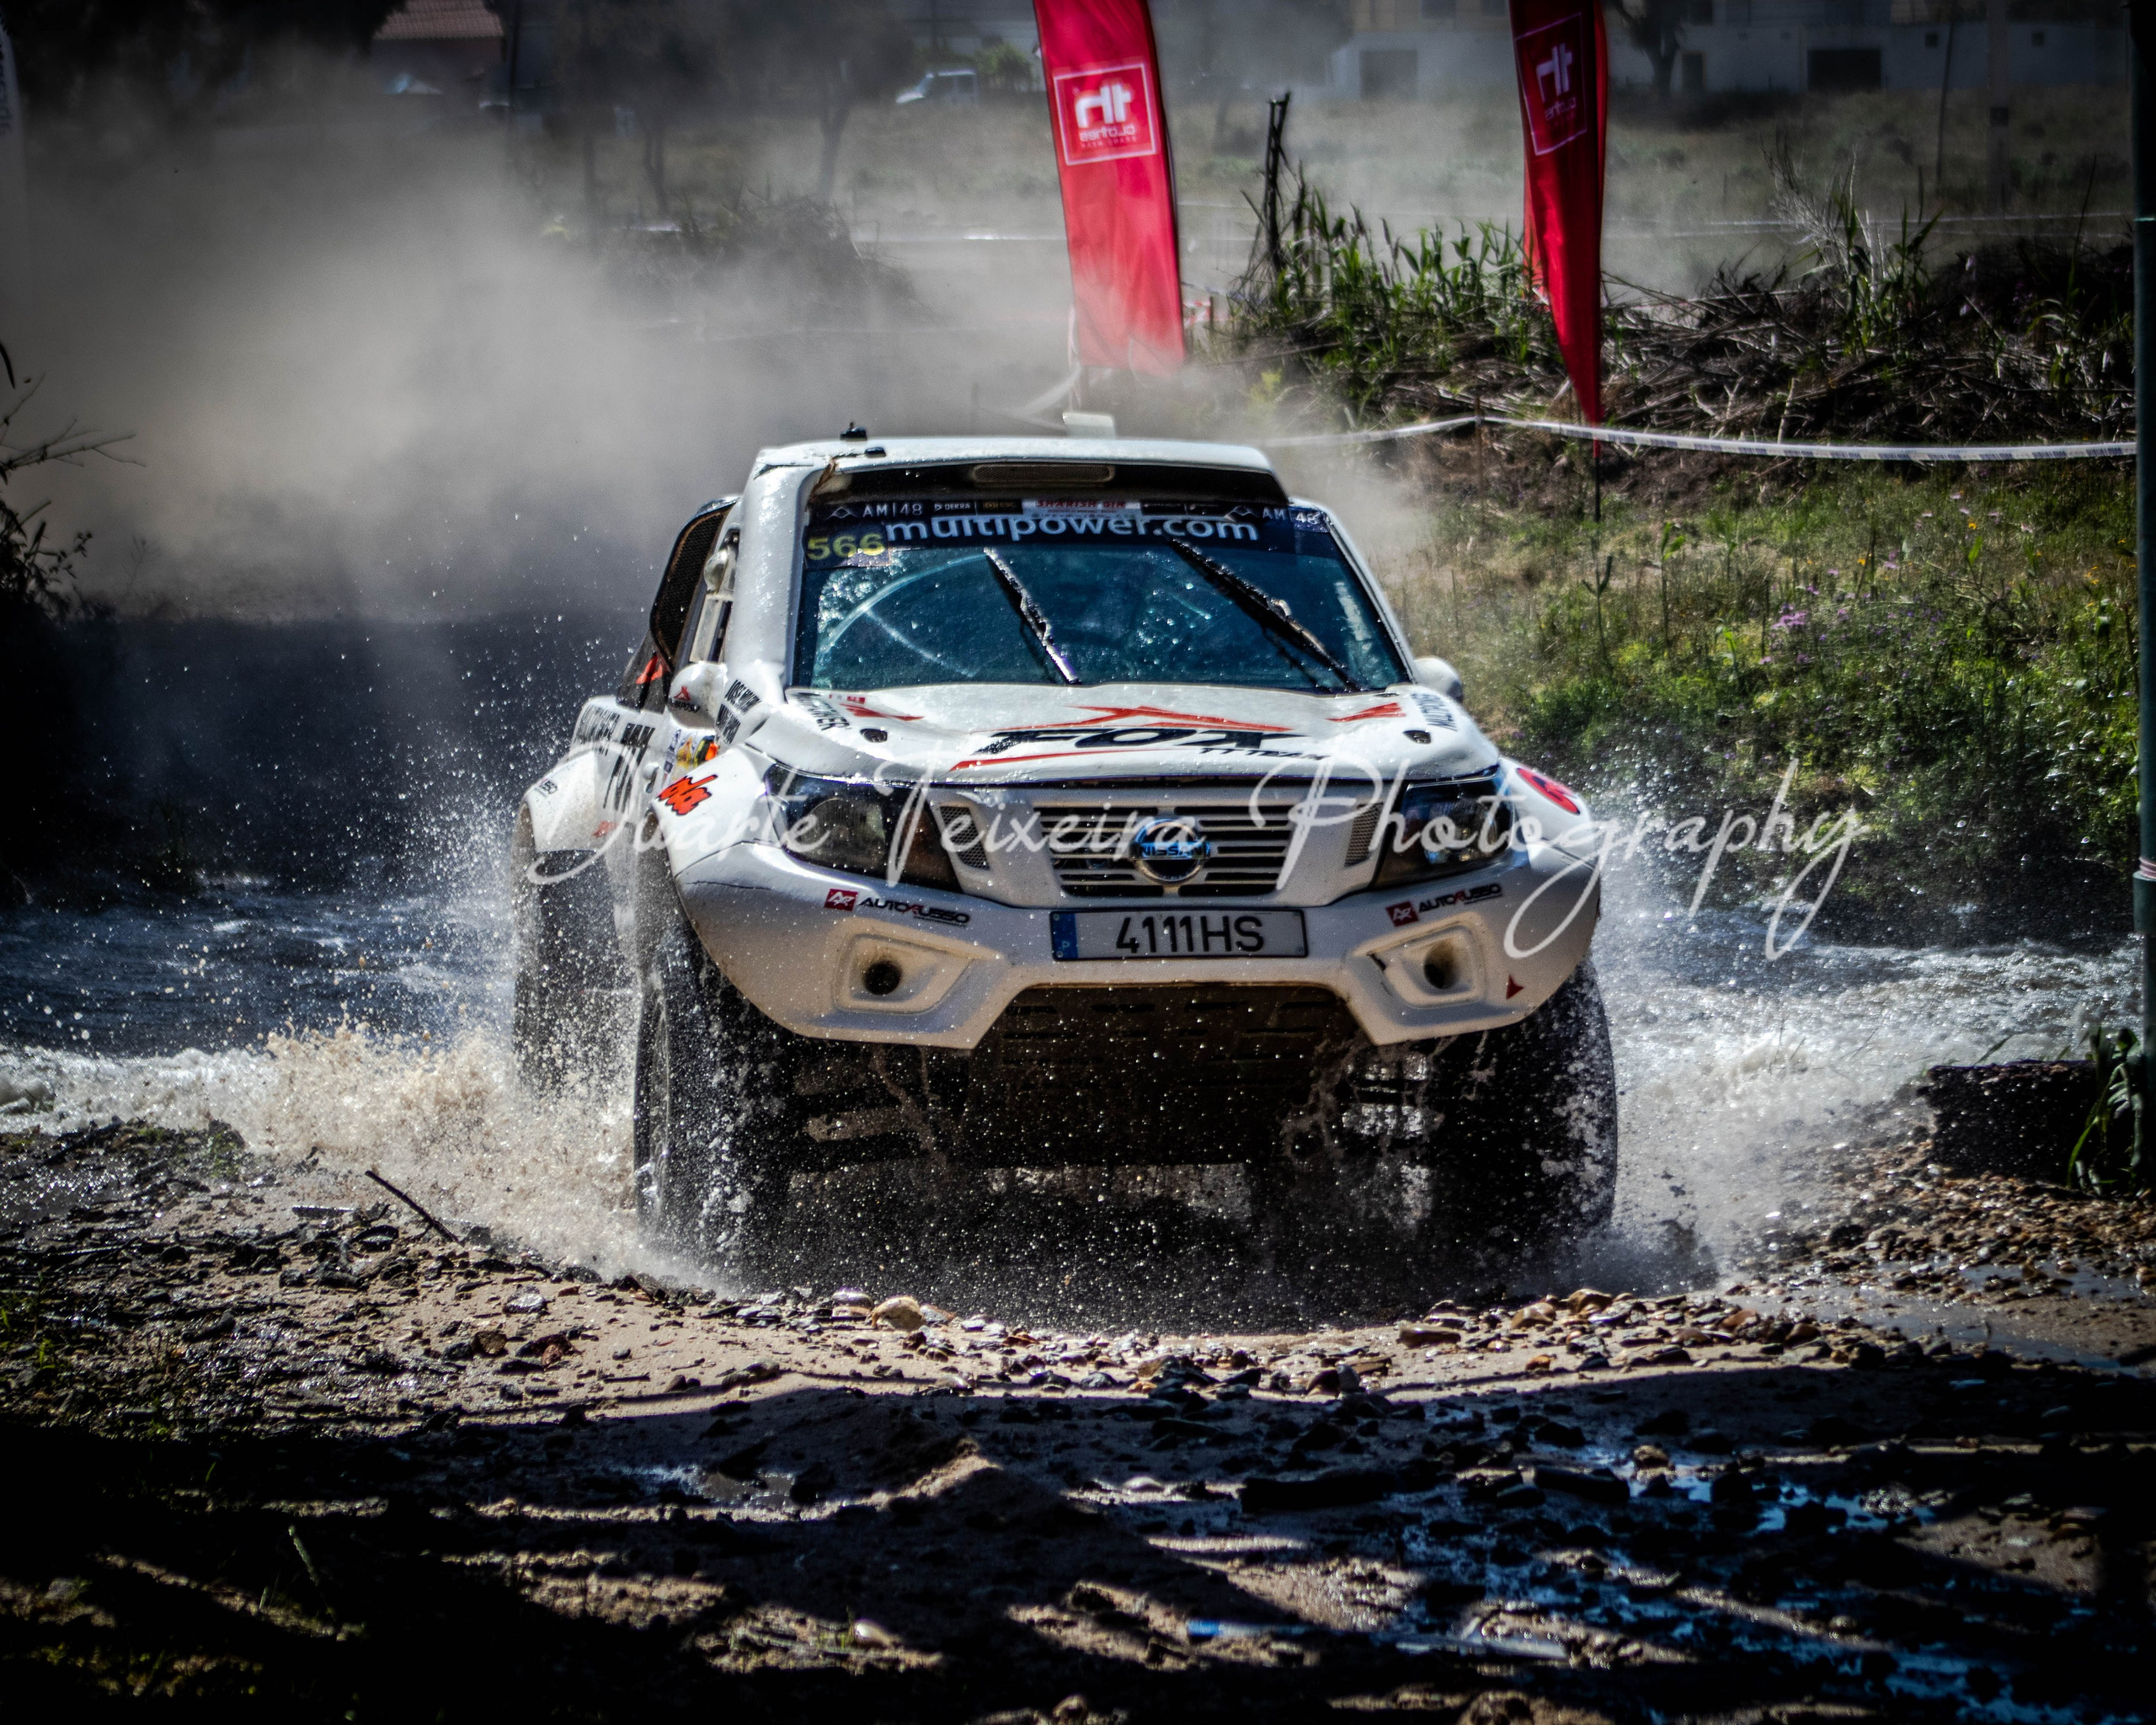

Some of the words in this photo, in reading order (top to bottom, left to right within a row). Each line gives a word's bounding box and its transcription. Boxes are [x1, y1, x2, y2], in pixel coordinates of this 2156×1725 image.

[944, 502, 970, 510] DEKRA
[886, 515, 1258, 542] multipower.com
[807, 532, 885, 561] 566
[1140, 846, 1203, 856] NISSAN
[1116, 916, 1264, 953] 4111HS
